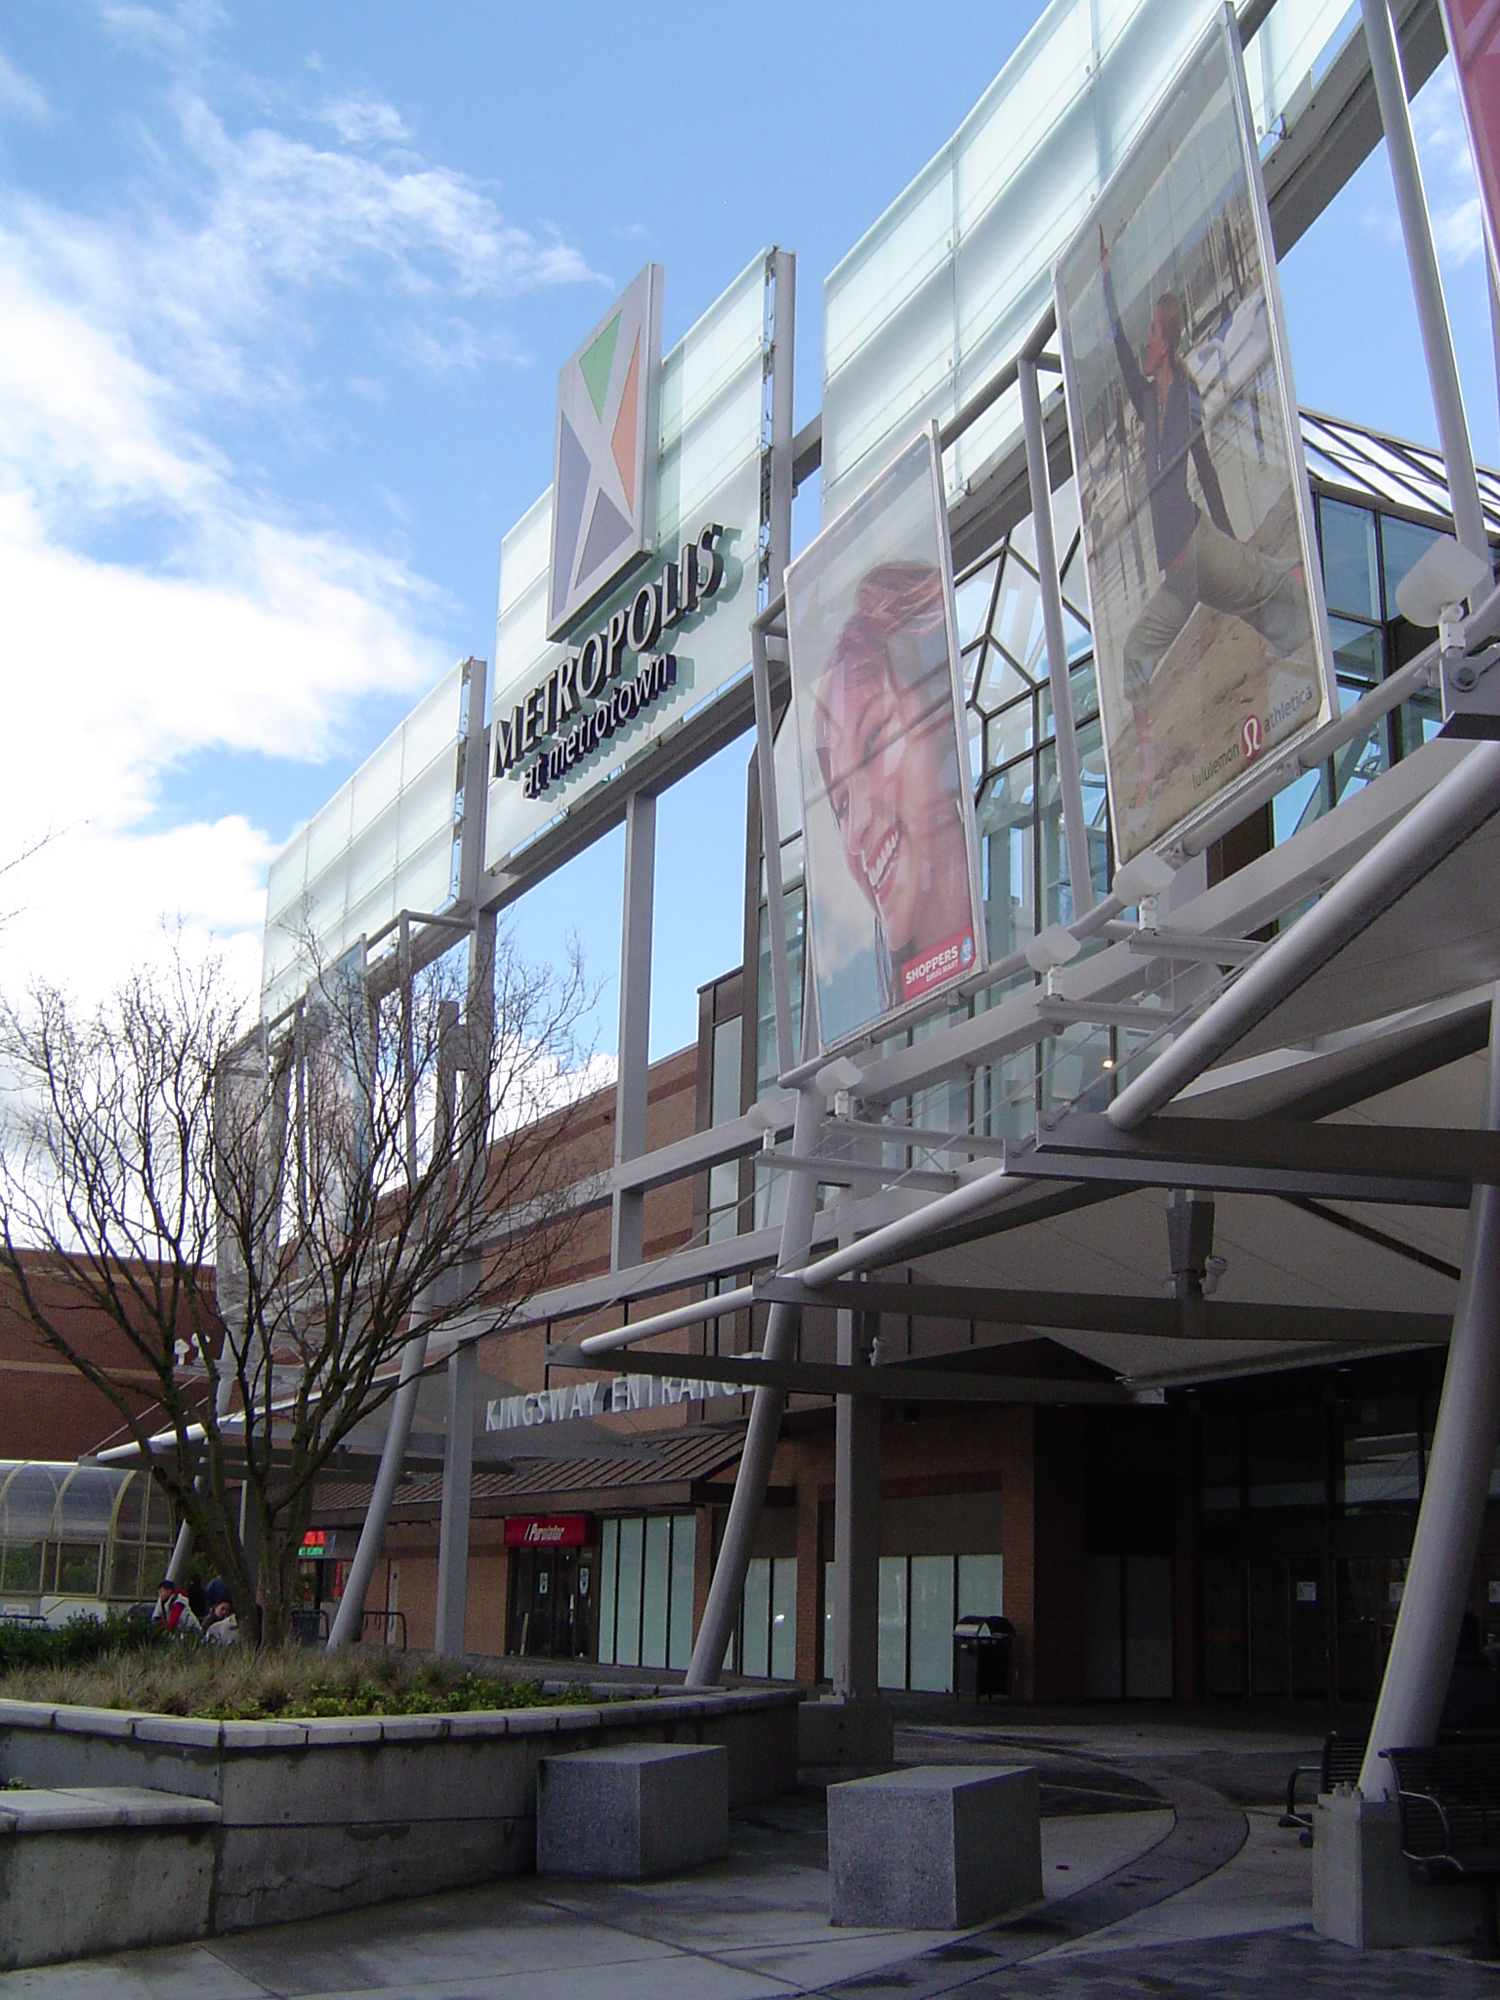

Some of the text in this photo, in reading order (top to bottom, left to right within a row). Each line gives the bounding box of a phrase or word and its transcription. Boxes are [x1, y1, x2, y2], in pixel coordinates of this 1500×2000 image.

[493, 522, 724, 778] METROPOLIS
[522, 653, 677, 800] at metrotown
[1192, 686, 1313, 790] lululemon athletica
[905, 945, 958, 985] SHOPPERS
[485, 1381, 601, 1432] KINGSWAY
